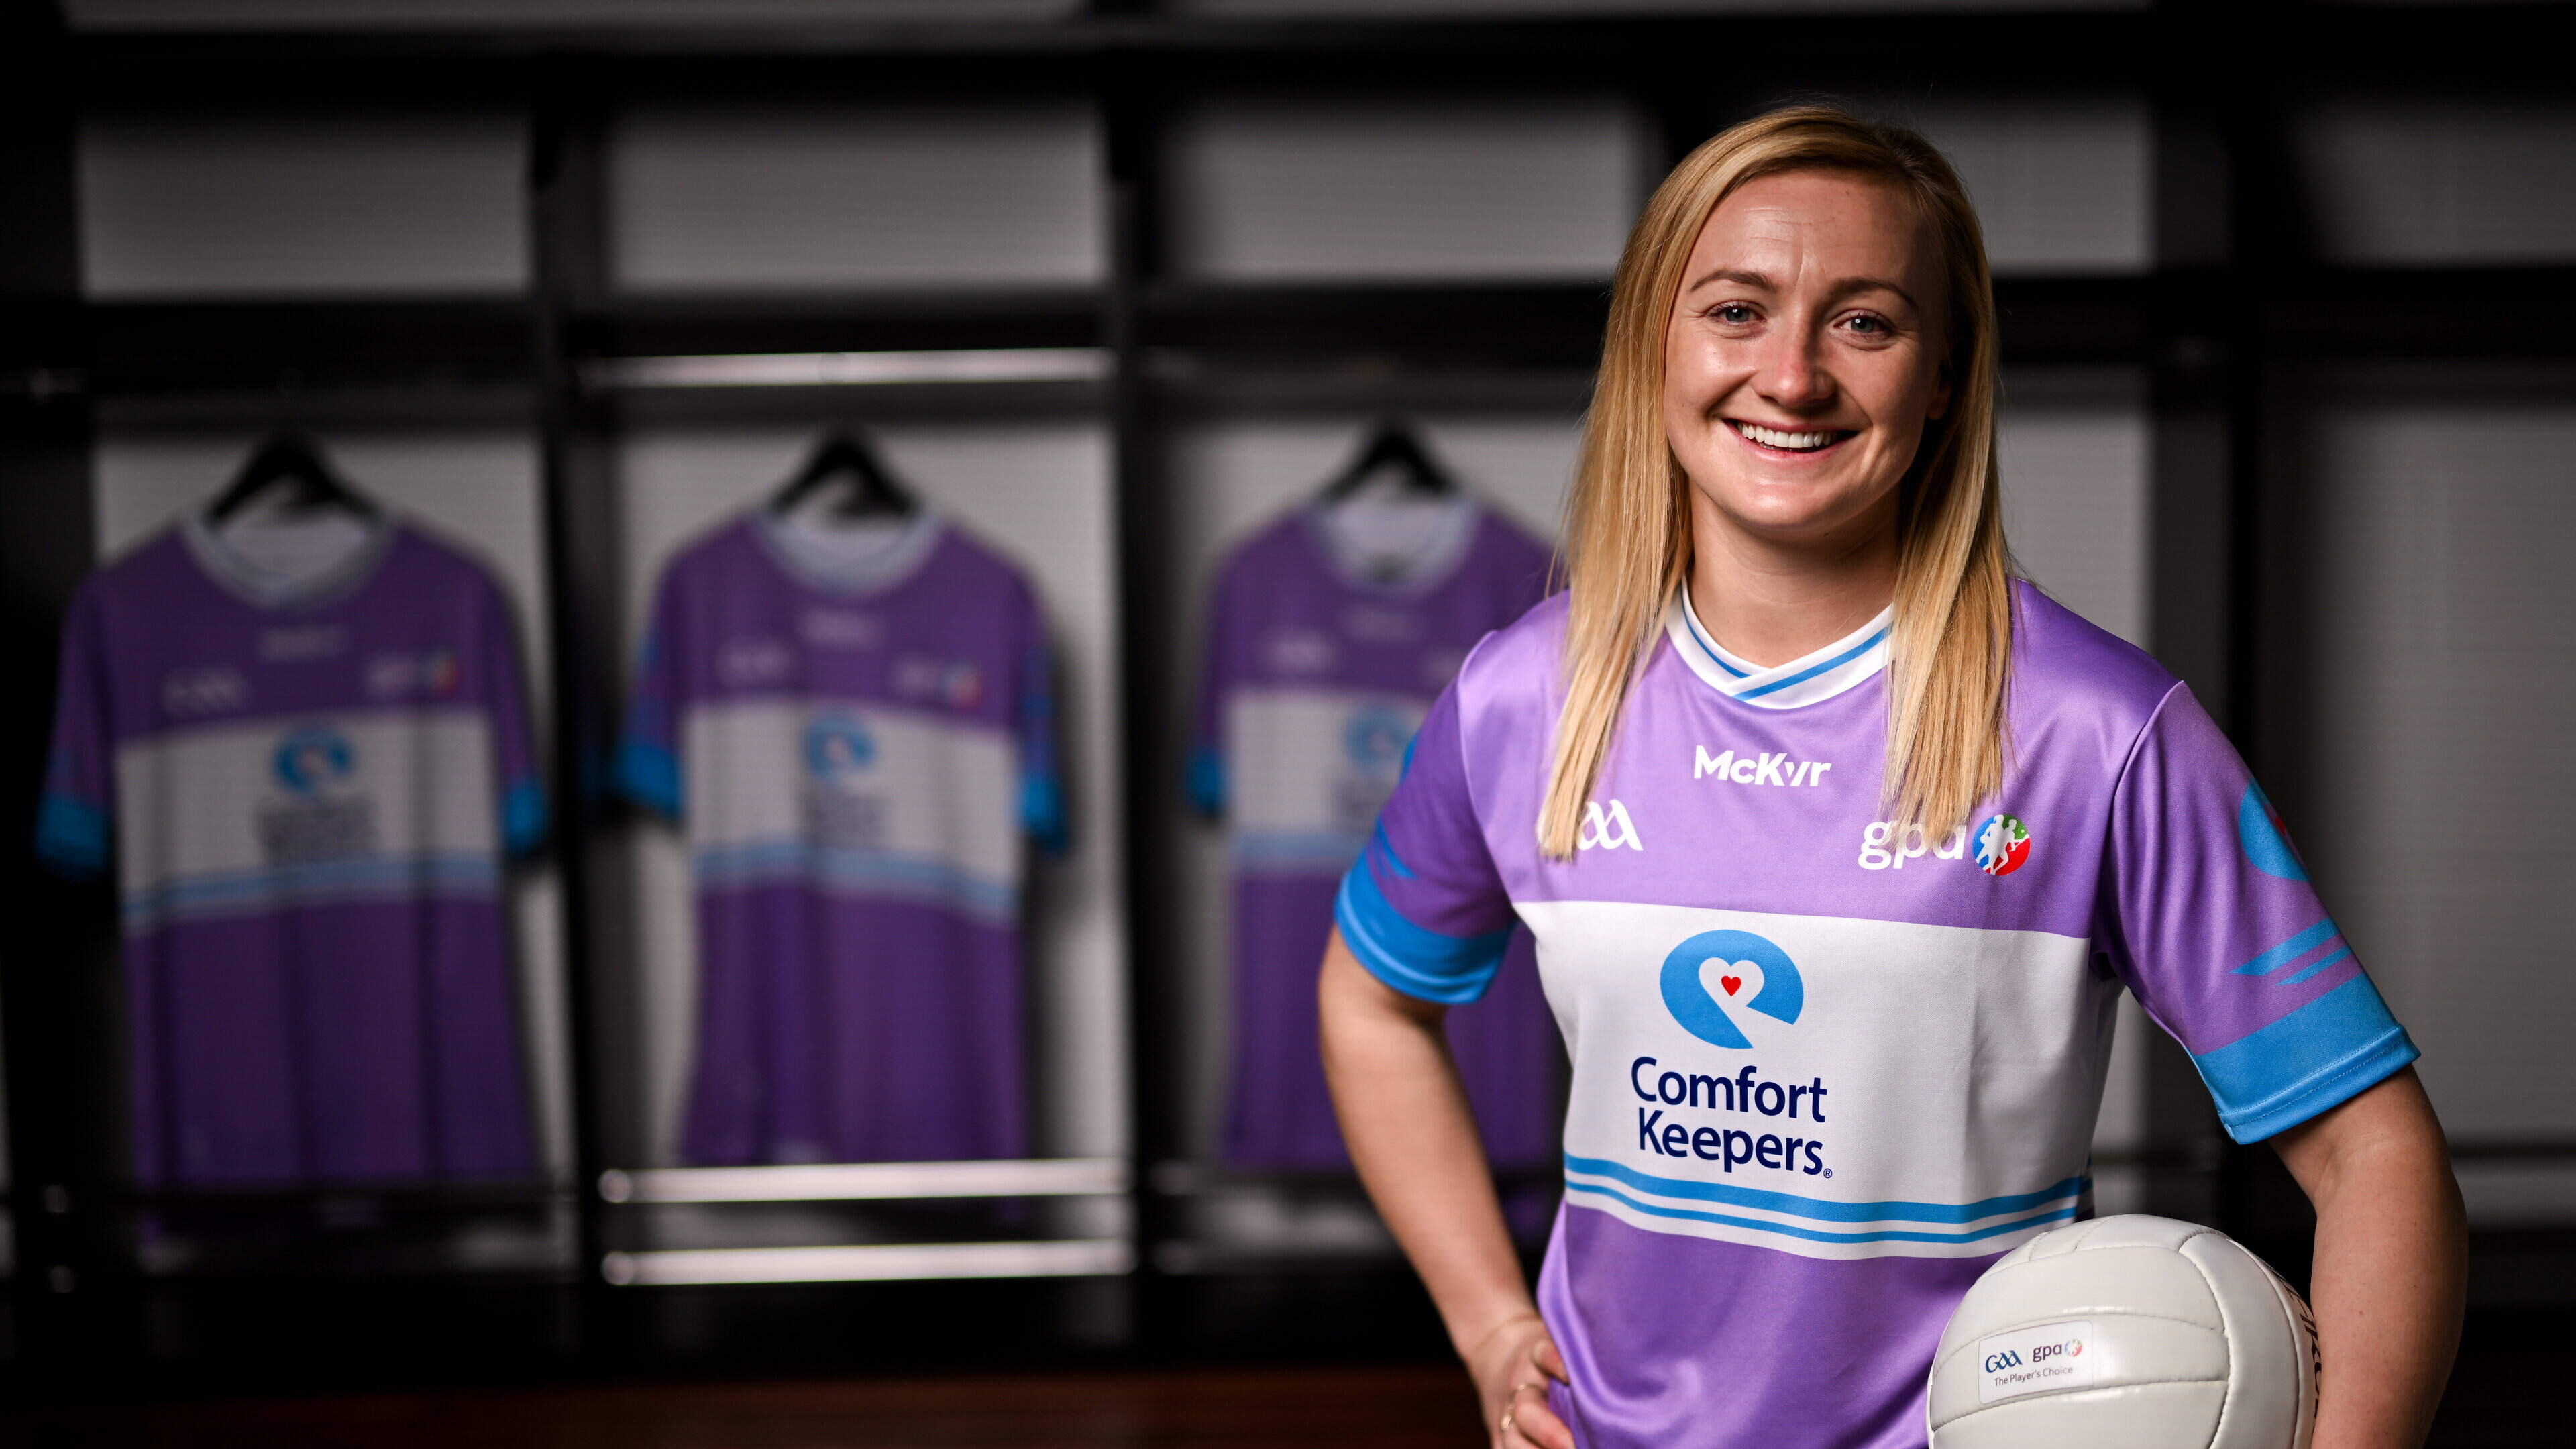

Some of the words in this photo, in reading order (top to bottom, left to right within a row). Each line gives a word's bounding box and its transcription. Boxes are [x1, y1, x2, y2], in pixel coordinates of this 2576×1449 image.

[1537, 799, 1644, 851] AA
[1631, 1057, 1827, 1122] Comfort
[1985, 1350, 2023, 1373] GAA
[2033, 1344, 2062, 1363] gpa
[1994, 1377, 2008, 1387] The
[2043, 1366, 2074, 1377] Choice
